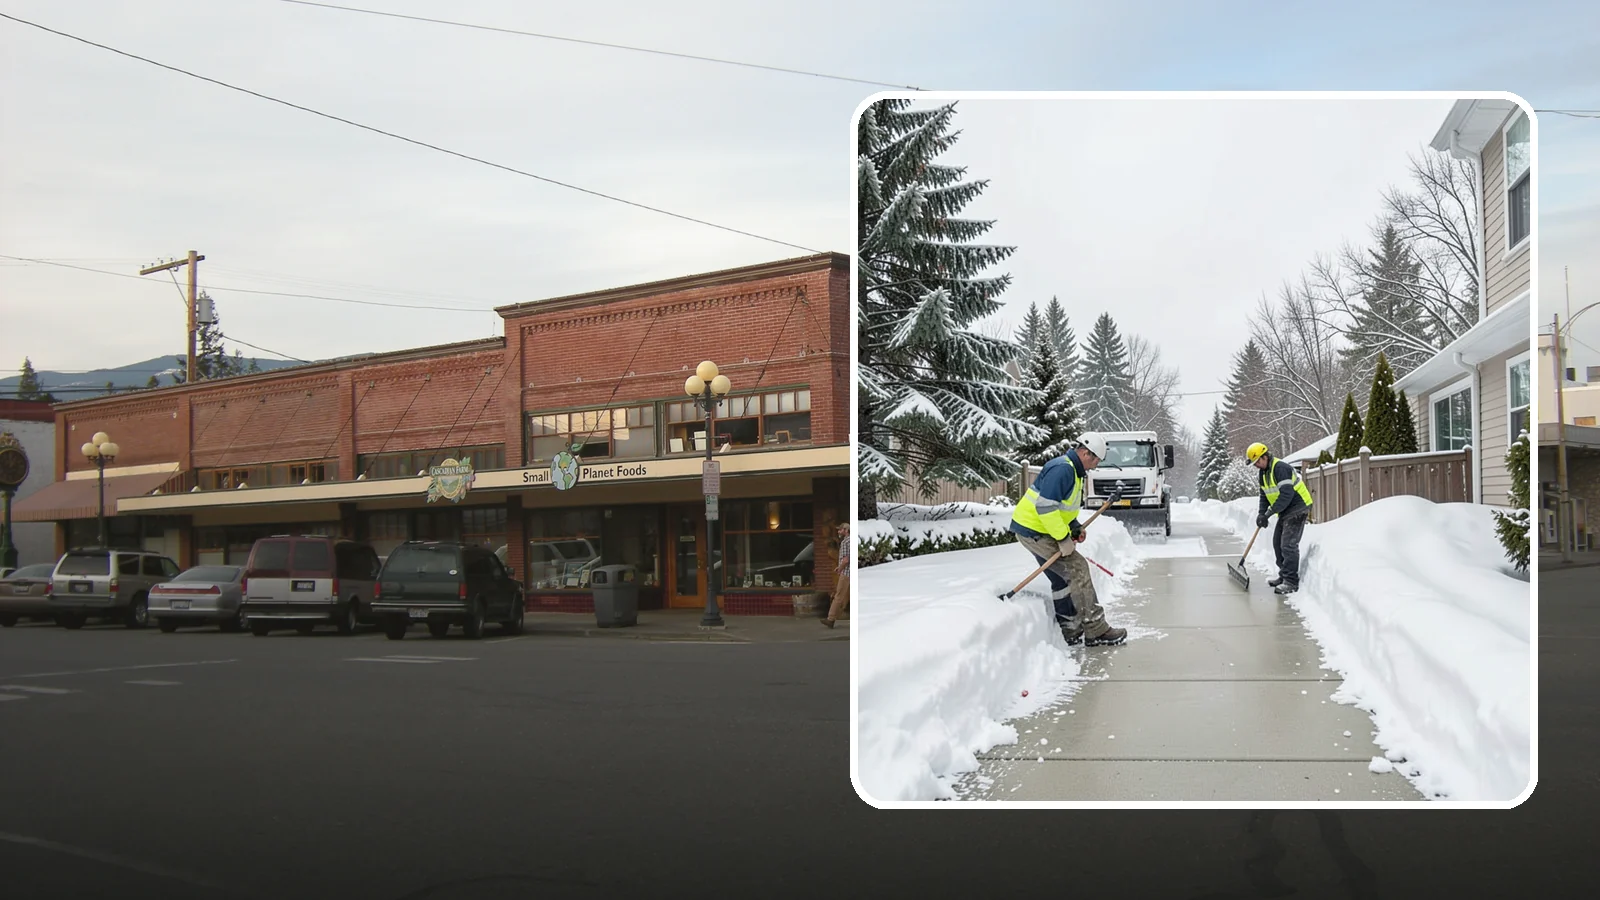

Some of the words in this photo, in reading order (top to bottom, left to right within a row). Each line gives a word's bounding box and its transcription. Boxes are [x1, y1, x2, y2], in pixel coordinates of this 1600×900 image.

[523, 471, 549, 483] Small
[582, 467, 614, 479] Planet
[616, 464, 647, 477] Foods
